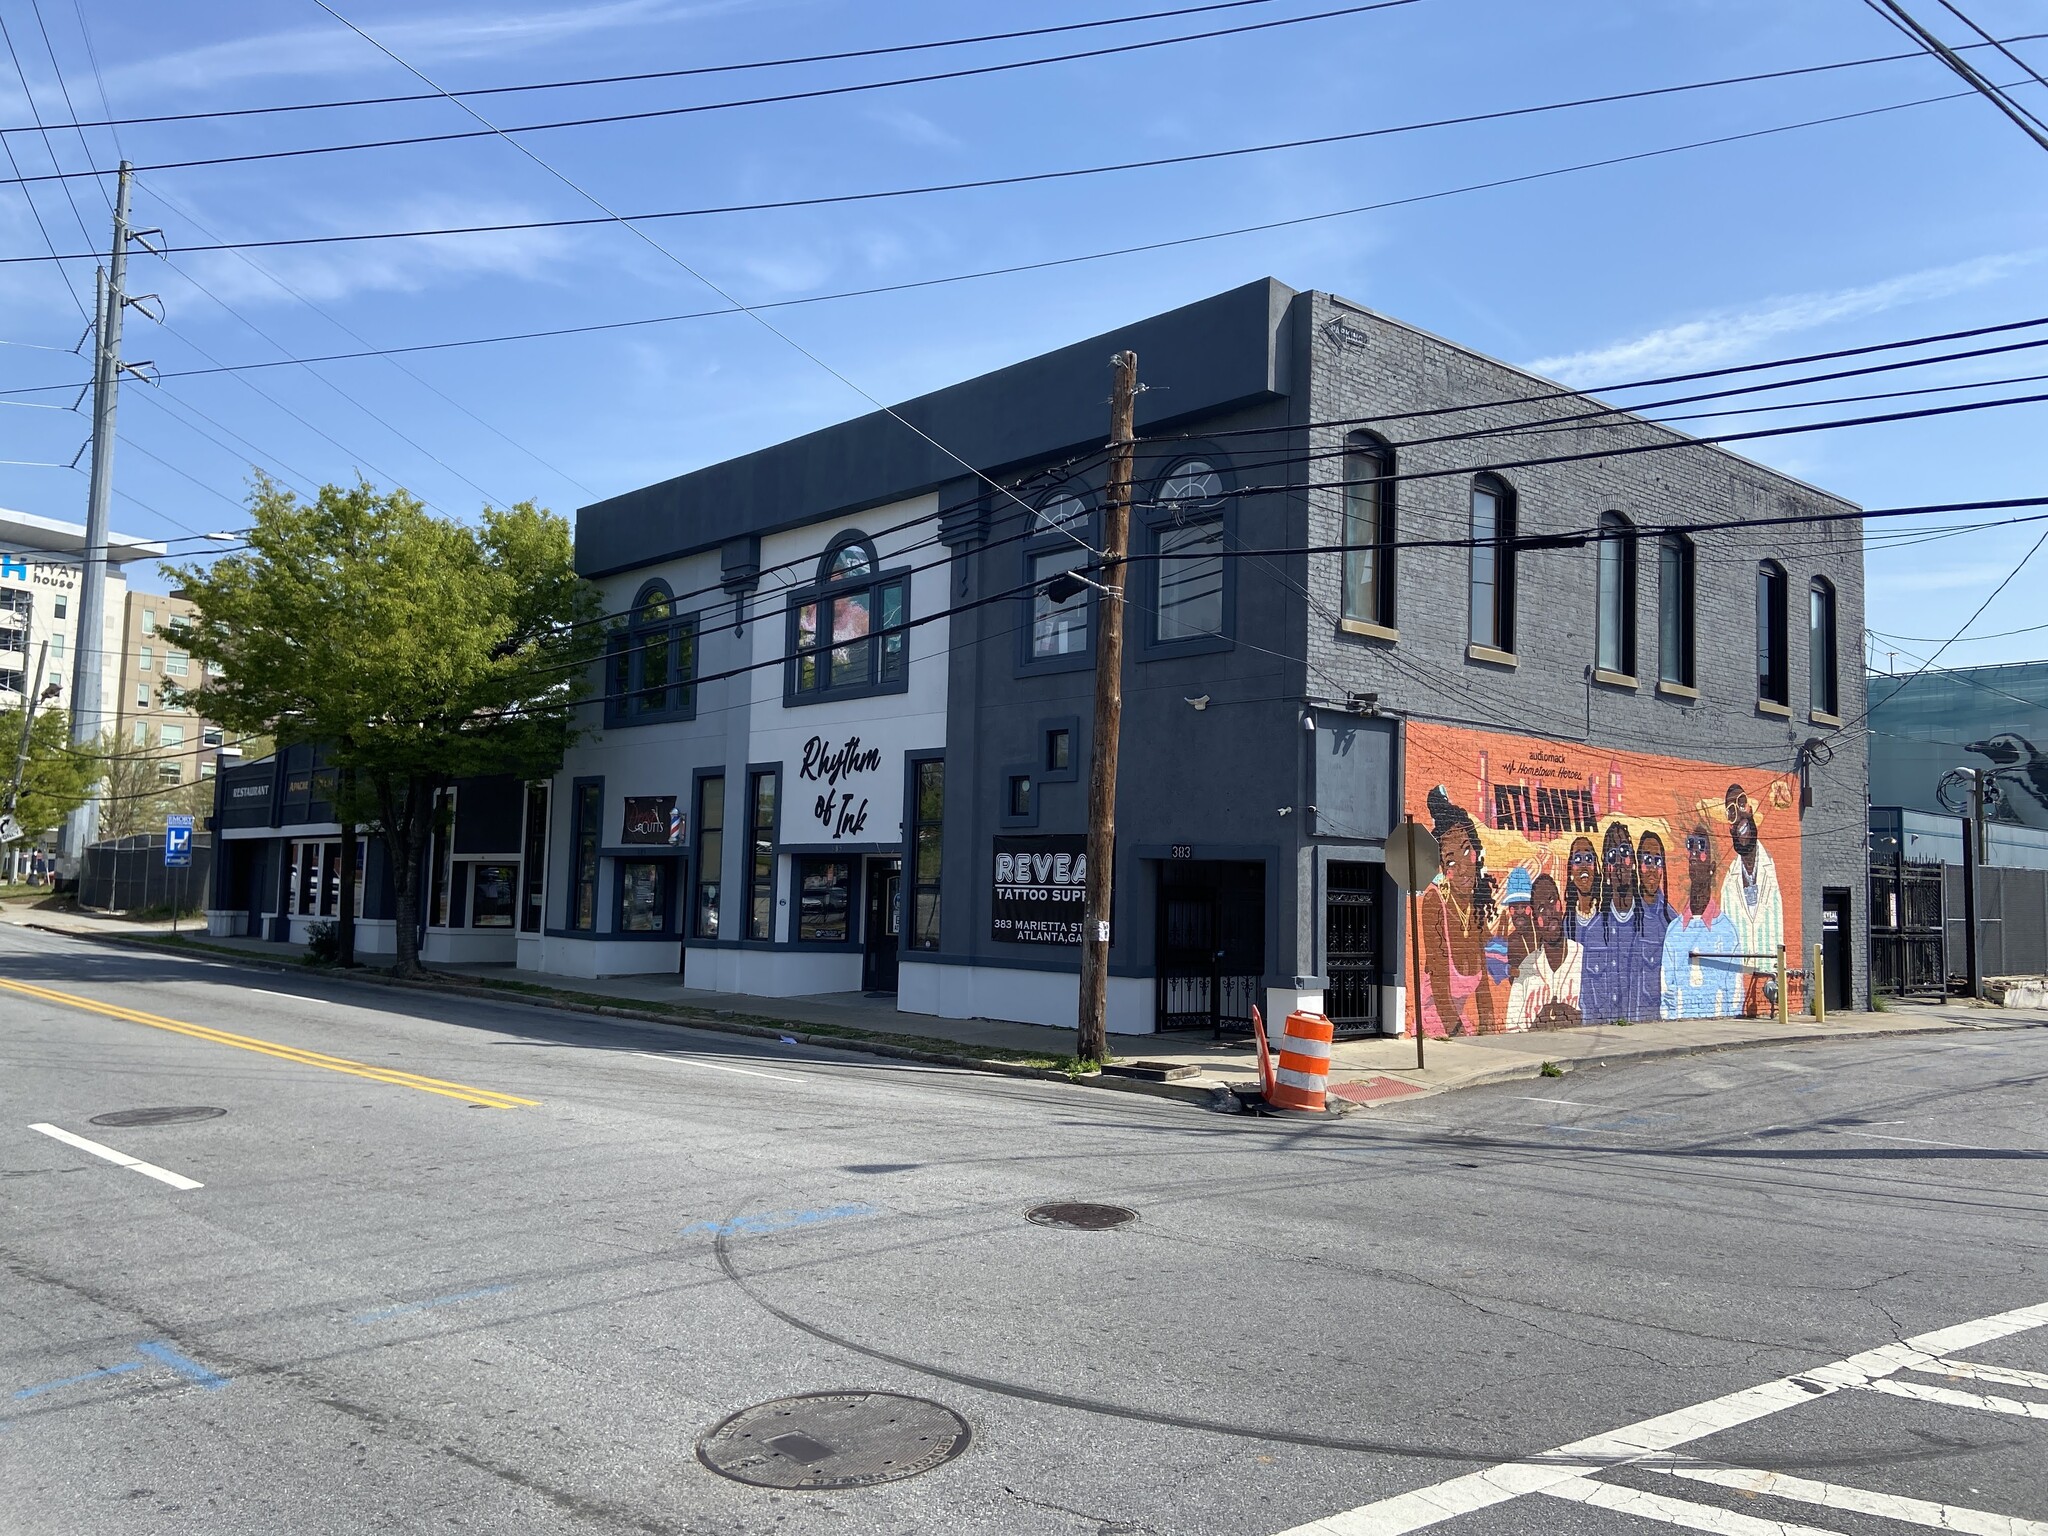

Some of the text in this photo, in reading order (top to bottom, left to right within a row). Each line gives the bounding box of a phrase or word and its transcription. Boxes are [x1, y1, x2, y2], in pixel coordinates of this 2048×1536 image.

[33, 573, 74, 589] house
[800, 736, 881, 786] Rhythm
[1529, 752, 1566, 763] audiomack
[1518, 763, 1583, 780] Hometown Heroes
[233, 785, 269, 797] RESTAURANT
[815, 788, 868, 839] of Ink
[1494, 784, 1599, 833] ATLANTA
[1172, 846, 1191, 858] 383
[997, 889, 1048, 901] TATTOO
[994, 920, 1012, 929] 383
[1015, 920, 1067, 932] MARIETTA
